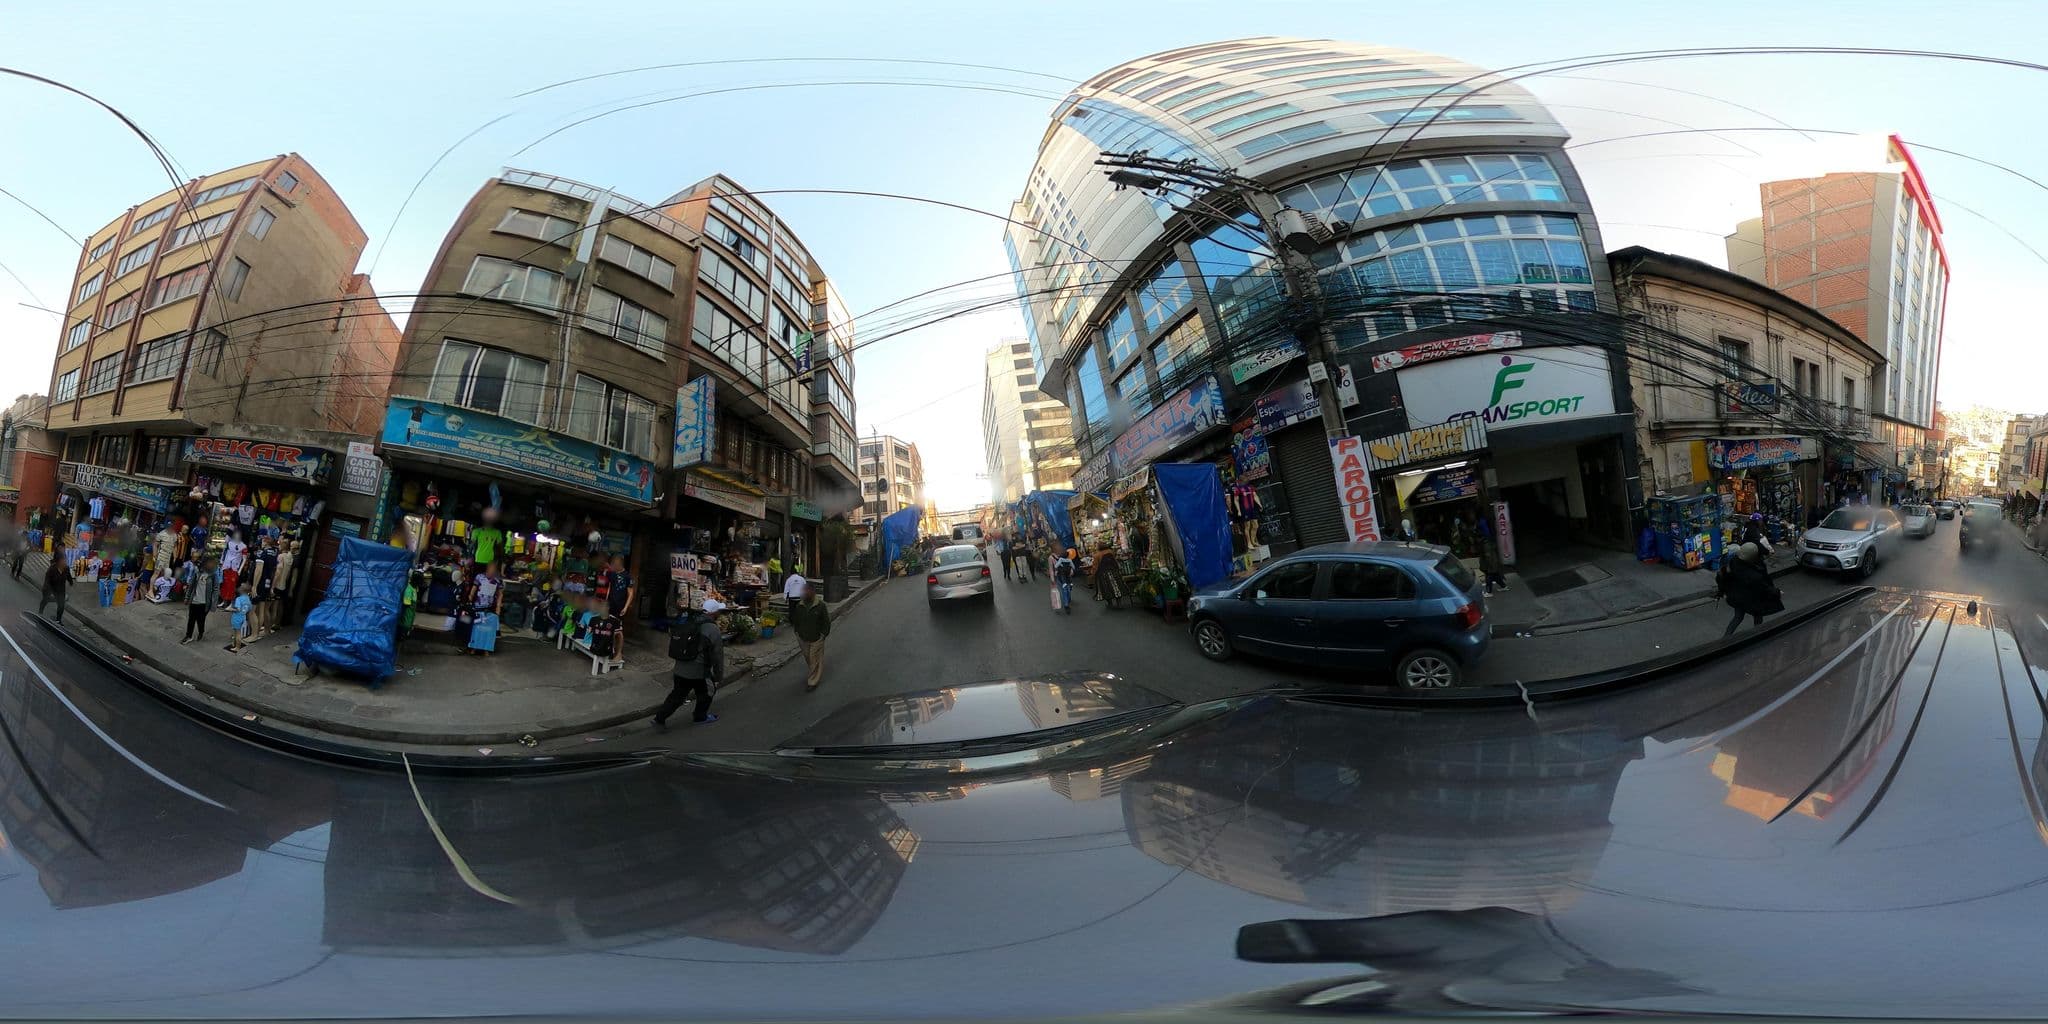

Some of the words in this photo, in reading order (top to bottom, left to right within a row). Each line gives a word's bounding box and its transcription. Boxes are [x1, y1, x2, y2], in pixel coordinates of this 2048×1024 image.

[1115, 388, 1195, 461] REKAR
[193, 438, 303, 464] REKAR
[1728, 441, 1755, 463] CASA
[345, 465, 377, 479] VENTA
[349, 457, 377, 470] CASA
